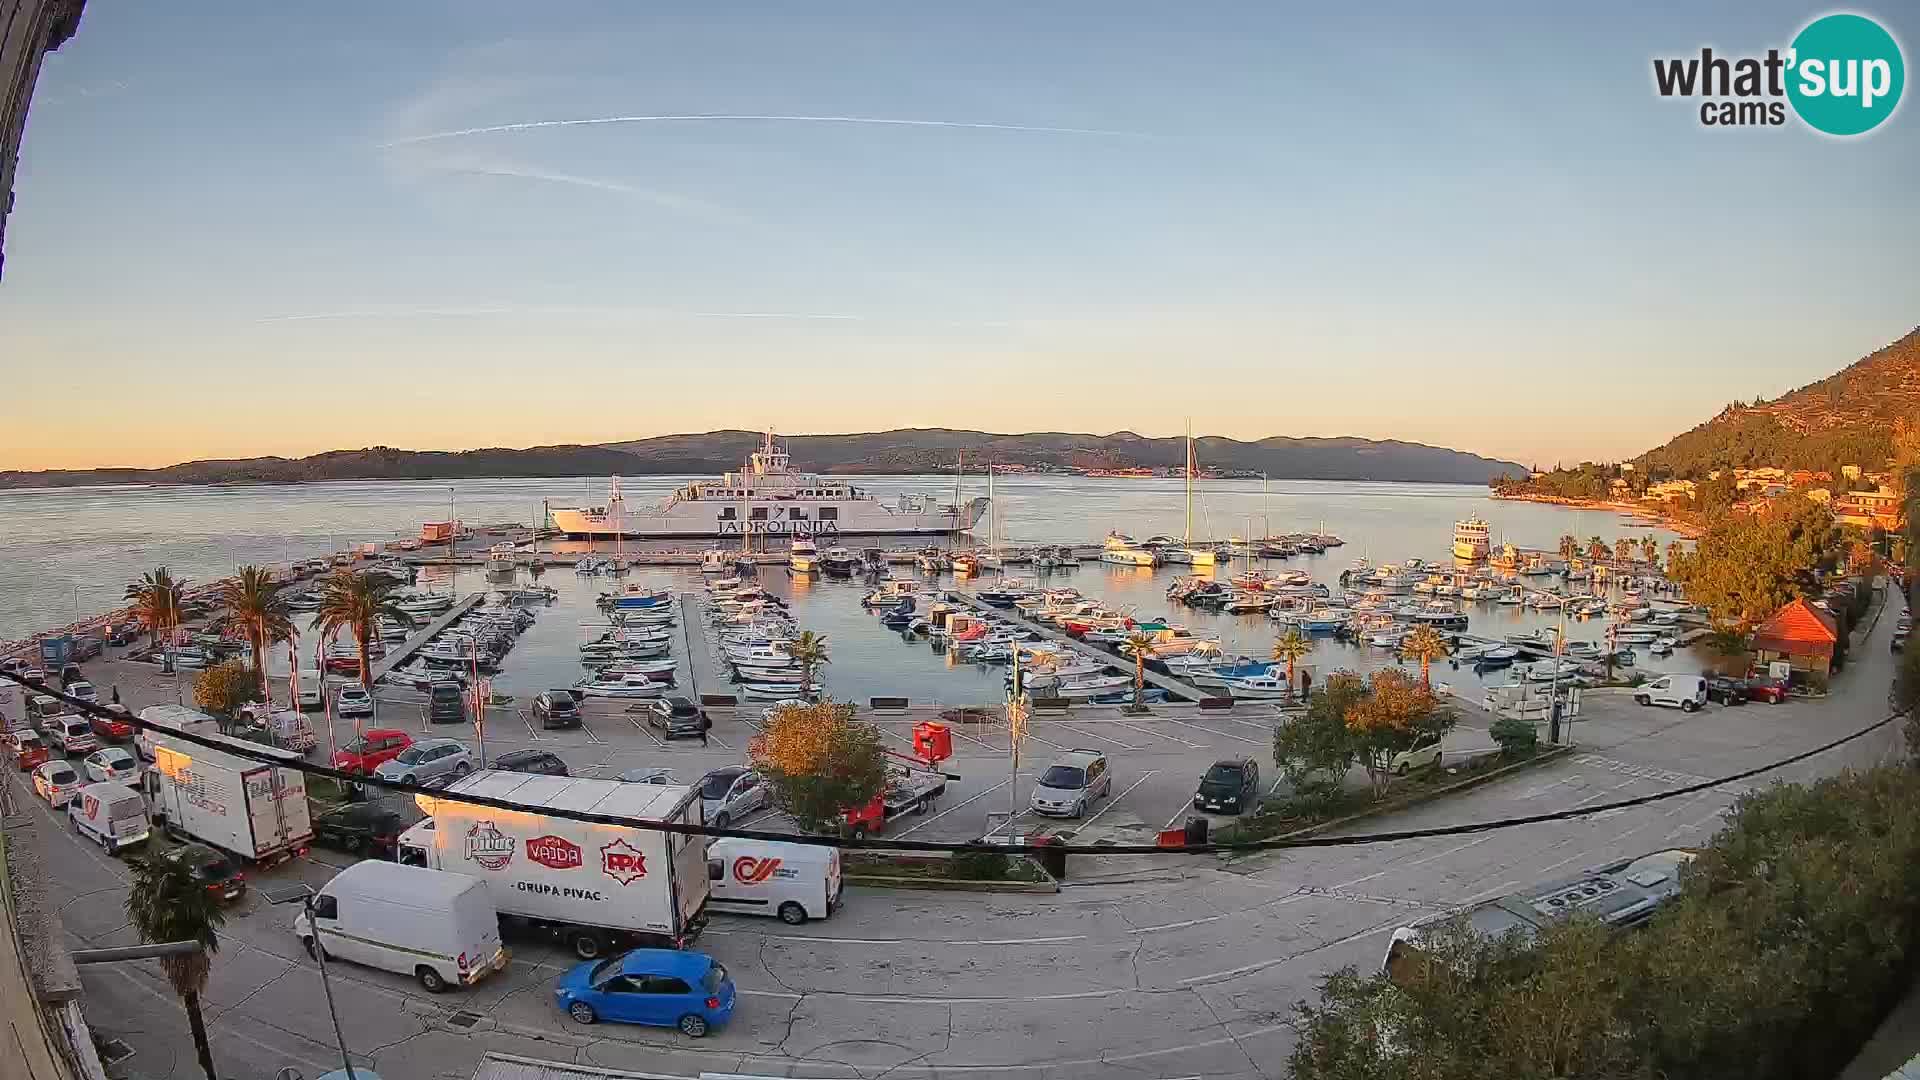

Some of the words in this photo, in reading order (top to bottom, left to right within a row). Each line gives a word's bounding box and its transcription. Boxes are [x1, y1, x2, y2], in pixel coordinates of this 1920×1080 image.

[717, 520, 840, 536] JADROLINIJA
[530, 844, 579, 863] VAJDA
[517, 881, 561, 897] GRUPA
[563, 887, 602, 901] PIVAC
